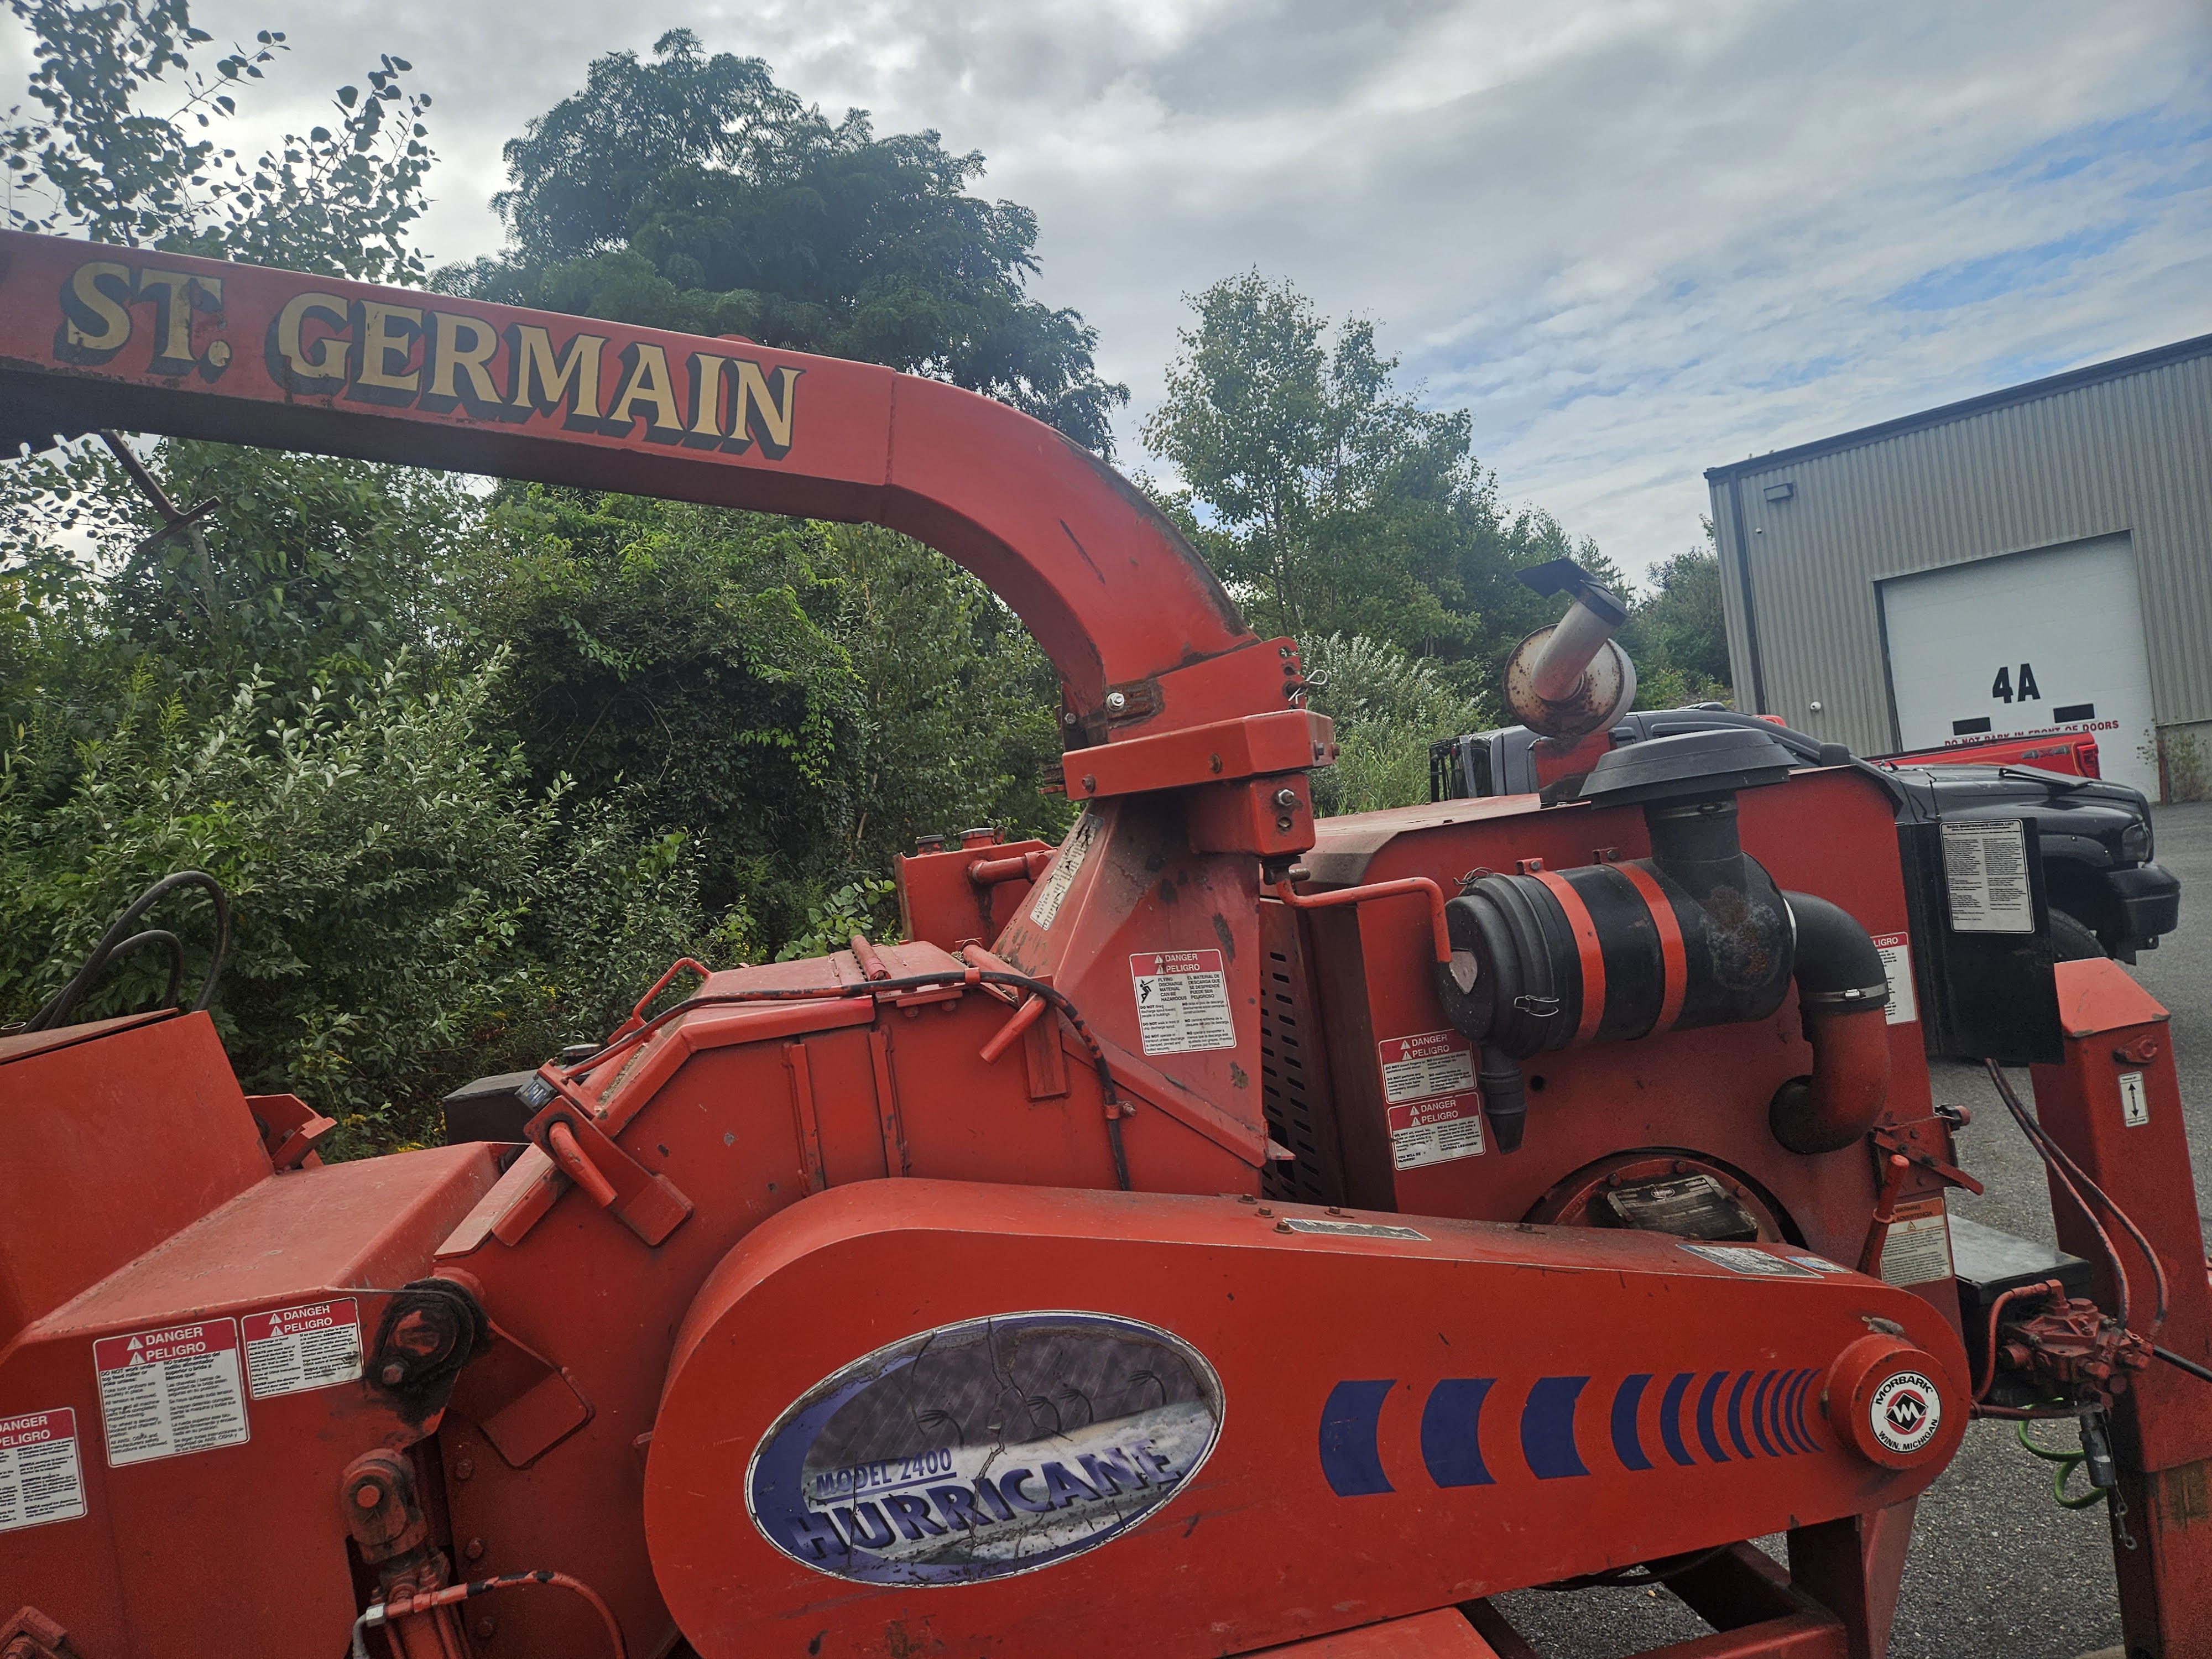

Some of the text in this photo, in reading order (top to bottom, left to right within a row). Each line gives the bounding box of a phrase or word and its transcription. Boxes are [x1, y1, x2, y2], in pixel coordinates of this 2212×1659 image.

[54, 261, 806, 460] ST. GERMAIN
[1992, 663, 2041, 703] 4A
[2083, 720, 2119, 731] DOORS
[1164, 953, 1198, 962] DANGER
[1165, 963, 1200, 972] PELIGRO
[1411, 1034, 1447, 1046] DANGER
[1412, 1044, 1449, 1057] PELIGRO
[1420, 1099, 1456, 1113] DANGER
[1421, 1110, 1459, 1124] PELIGRO
[283, 1305, 330, 1321] DANGER
[284, 1316, 332, 1333] PELIGRO
[145, 1326, 203, 1345] DANGER
[145, 1341, 206, 1361] PELIGRO
[1875, 1375, 1932, 1405] MORBARK
[0, 1428, 50, 1447] ELIGRO
[1879, 1418, 1938, 1451] WINN, MICHIGAN
[815, 1447, 952, 1498] MODEL 2400
[784, 1438, 1183, 1561] HURRICANE
